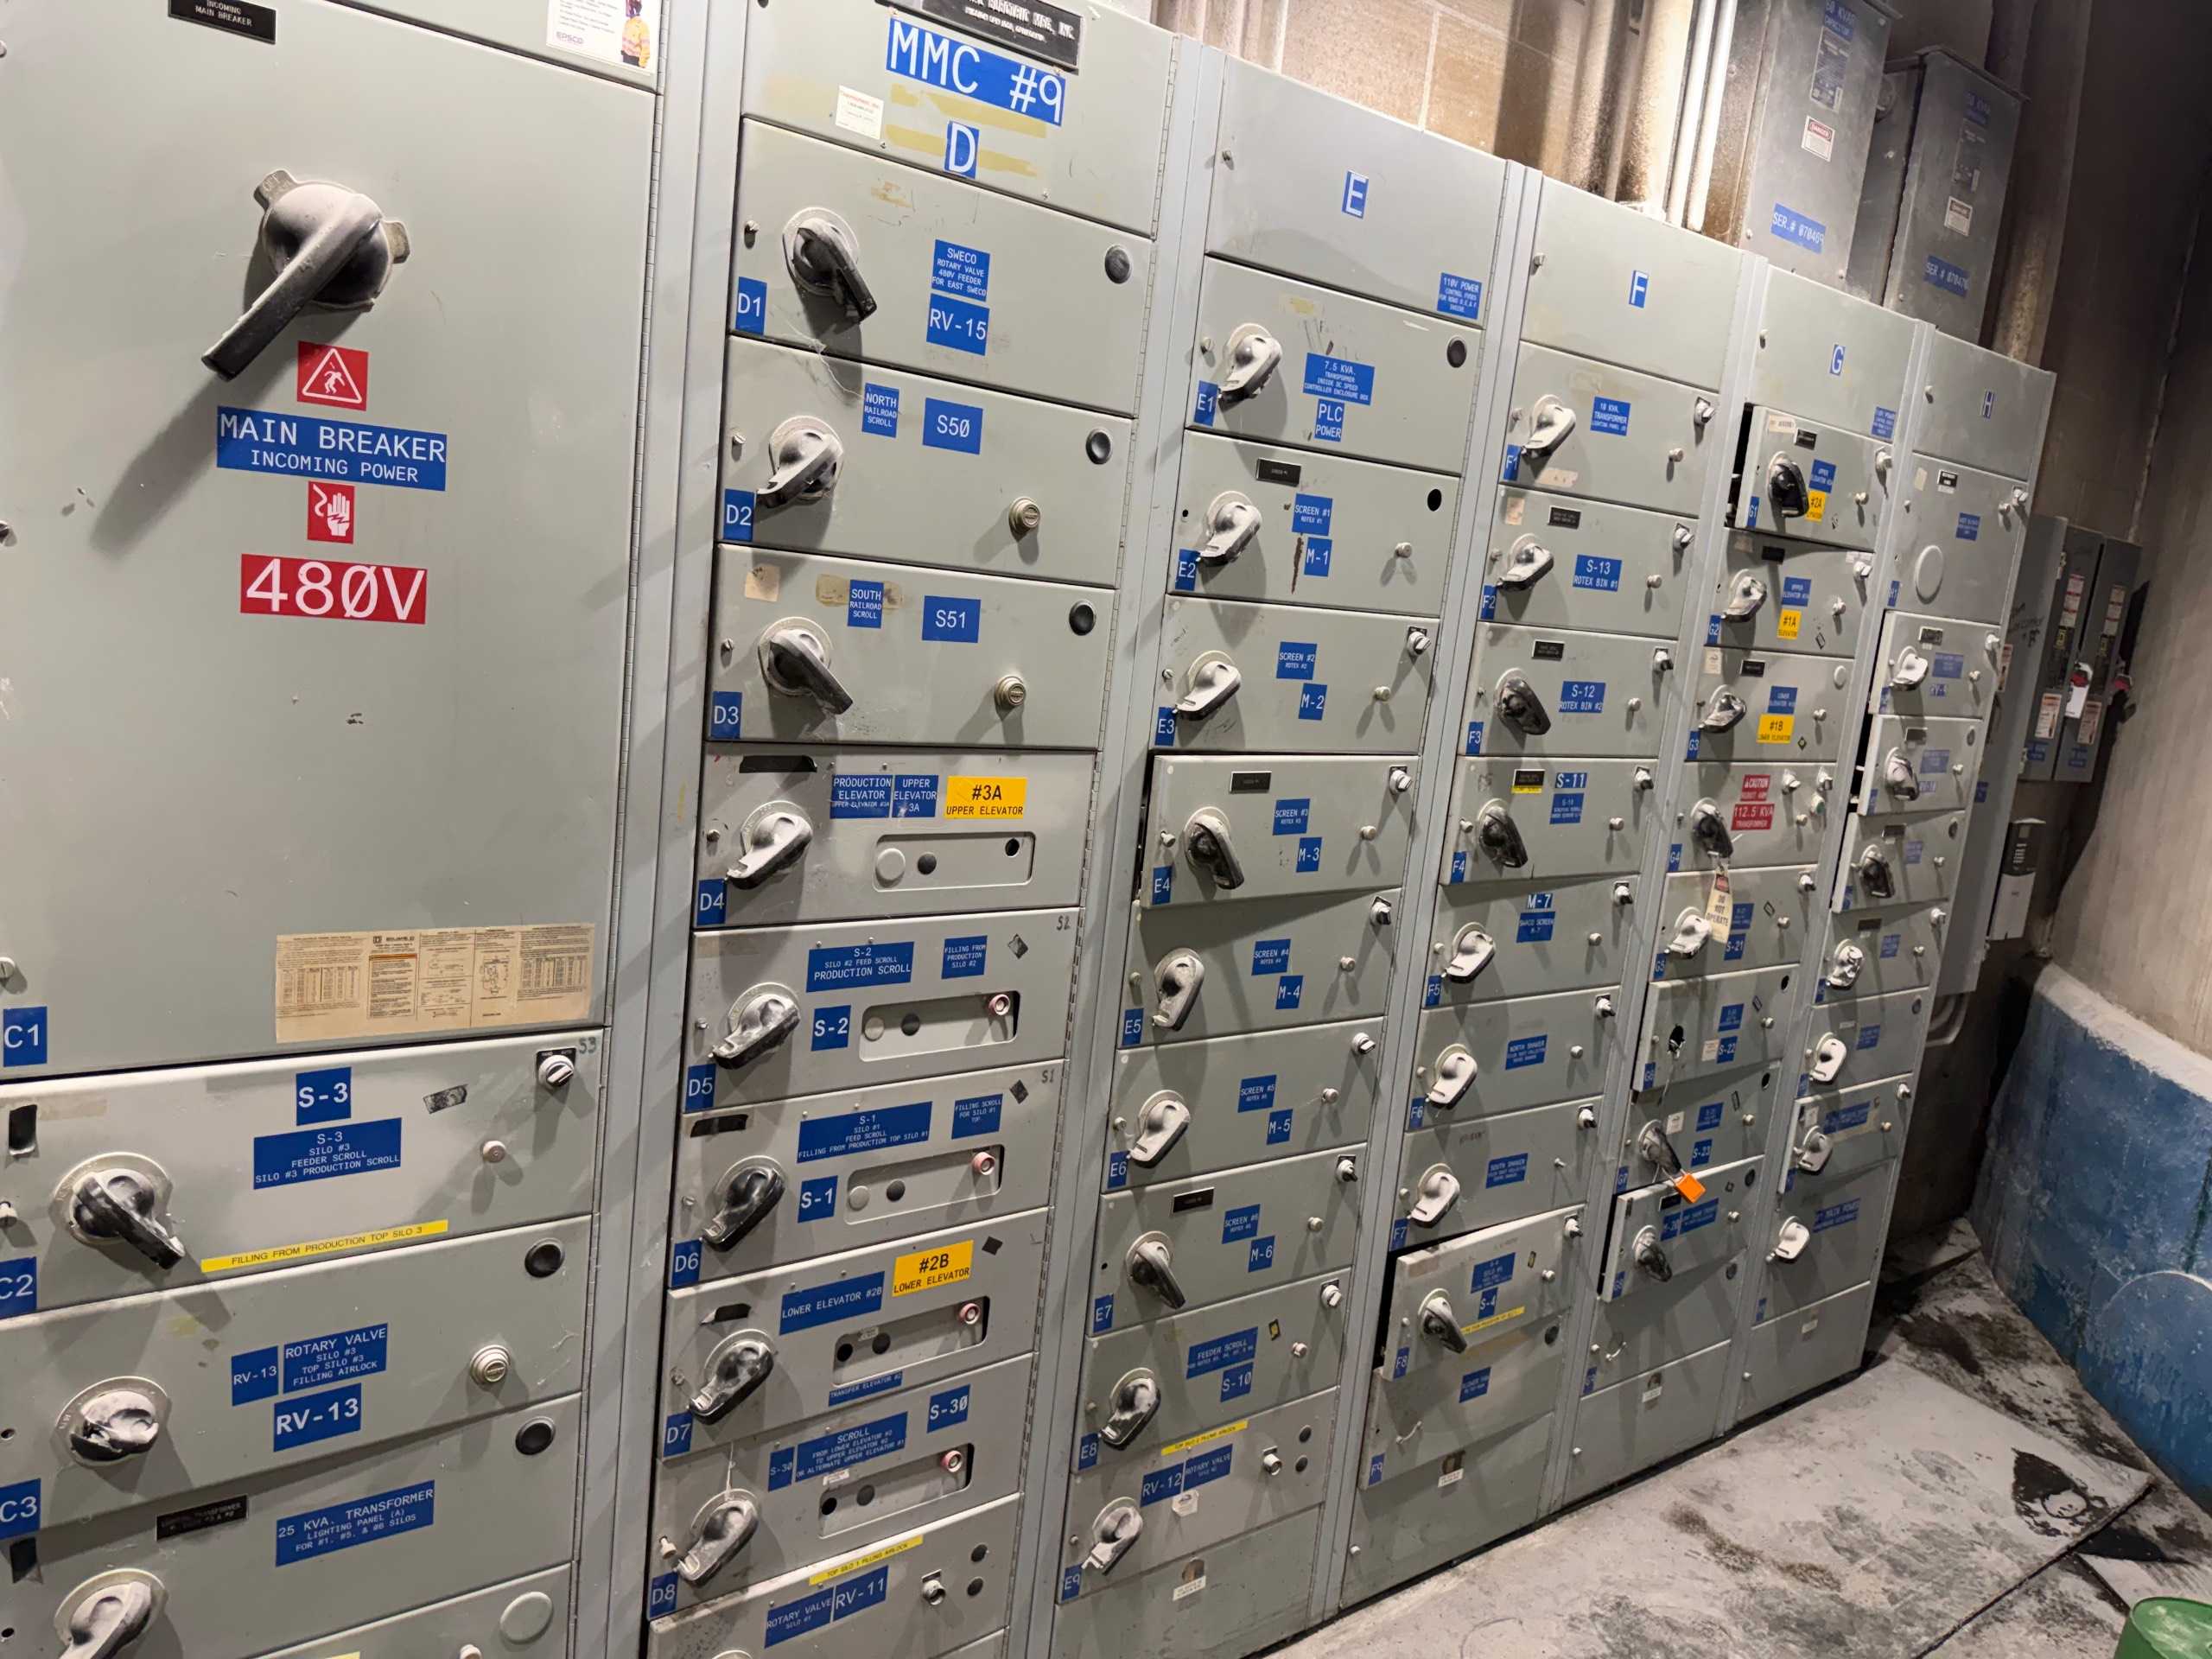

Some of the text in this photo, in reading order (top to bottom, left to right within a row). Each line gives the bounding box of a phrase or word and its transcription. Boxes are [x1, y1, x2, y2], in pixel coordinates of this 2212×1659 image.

[195, 5, 253, 27] MAIN BREAKER
[890, 21, 981, 93] MMC
[1010, 65, 1064, 123] #9
[949, 122, 976, 173] D
[1346, 172, 1368, 216] E
[947, 247, 976, 264] SWECO
[938, 258, 984, 277] ROTARY VALVE
[958, 273, 982, 286] FEEDER
[1630, 270, 1649, 304] F
[738, 293, 761, 317] D1
[930, 308, 986, 340] RV-15
[1325, 360, 1338, 372] 7.5
[1831, 345, 1844, 374] G
[866, 393, 897, 407] NORTH
[1198, 394, 1213, 412] E1
[1319, 403, 1344, 423] PLC
[868, 416, 893, 428] SCROLL
[936, 415, 970, 437] S50
[220, 413, 446, 463] MAIN BREAKER
[1315, 424, 1341, 439] POWER
[251, 449, 418, 482] INCOMING POWER
[1506, 454, 1517, 471] F1
[727, 504, 752, 526] D2
[1294, 504, 1319, 517] SCREEN
[1306, 548, 1329, 565] M-1
[1178, 562, 1196, 579] E2
[1586, 558, 1611, 575] S-13
[1574, 575, 1609, 588] ROTEX BIN
[851, 588, 881, 601] SOUTH
[1482, 594, 1497, 610] F2
[849, 601, 882, 611] RAILROAD
[853, 610, 877, 619] SCROLL
[935, 610, 966, 629] S51
[1783, 615, 1797, 627] #1A
[1708, 623, 1719, 636] G2
[1279, 652, 1316, 663] SCREEN #2
[1571, 684, 1595, 698] S-12
[1301, 694, 1325, 709] M-2
[1559, 701, 1593, 710] ROTEX BIN
[714, 705, 739, 725] D3
[1158, 718, 1175, 735] E3
[1769, 720, 1783, 732] #1B
[1469, 730, 1482, 745] F3
[1689, 739, 1700, 751] G3
[833, 778, 891, 788] PRODUCTION
[903, 779, 930, 788] UPPER
[1556, 773, 1586, 788] S-11
[839, 790, 886, 800] ELEVATOR
[894, 791, 938, 801] ELEVATOR
[972, 785, 1002, 801] #3A
[946, 805, 1023, 816] UPPER ELEVATOR
[1275, 808, 1300, 818] SCREEN
[1734, 805, 1774, 818] 112.5 KVA
[1298, 847, 1320, 862] M-3
[1669, 850, 1681, 863] G4
[1452, 859, 1465, 873] F4
[1154, 876, 1171, 893] E4
[700, 893, 725, 910] D4
[1527, 893, 1553, 908] M-7
[1706, 912, 1728, 926] OPERATE
[854, 947, 872, 957] S-2
[1255, 949, 1279, 958] SCREEN
[1726, 940, 1744, 953] S-21
[814, 963, 911, 981] PRODUCTION SCROLL
[1278, 984, 1300, 1000] M-4
[1428, 983, 1440, 996] F5
[814, 1017, 849, 1037] S-2
[1124, 1018, 1141, 1034] E5
[3, 1024, 40, 1048] C1
[1719, 1042, 1736, 1056] S-22
[689, 1077, 713, 1096] D5
[1241, 1087, 1265, 1096] SCREEN
[298, 1083, 348, 1108] S-3
[860, 1114, 876, 1125] S-1
[1411, 1105, 1424, 1119] F6
[1268, 1118, 1291, 1135] M-5
[317, 1131, 343, 1144] S-3
[309, 1143, 350, 1156] SILO #3
[291, 1150, 367, 1168] FEEDER SCROLL
[256, 1155, 400, 1184] SILO #3 PRODUCTION SCROLL
[1110, 1161, 1127, 1177] E6
[801, 1188, 834, 1209] S-1
[1224, 1216, 1249, 1228] SCREEN
[1394, 1227, 1407, 1240] F7
[232, 1228, 413, 1265] FILLING FROM PRODUCTION TOP SILO
[1250, 1244, 1274, 1262] M-6
[675, 1253, 699, 1273] D6
[918, 1253, 949, 1274] #2B
[0, 1274, 34, 1300] C2
[894, 1267, 969, 1294] LOWER ELEVATOR
[782, 1291, 861, 1319] LOWER ELEVATOR
[1479, 1294, 1497, 1310] S-4
[1095, 1304, 1113, 1322] E7
[285, 1327, 386, 1359] ROTARY VALVE
[1197, 1345, 1222, 1359] FEEDER
[1224, 1339, 1247, 1353] SCROLL
[316, 1351, 340, 1363] SILO
[1396, 1354, 1408, 1368] F8
[293, 1361, 378, 1386] FILLING AIRLOCK
[302, 1357, 348, 1375] TOP SILO
[233, 1366, 277, 1385] RV-13
[1222, 1371, 1252, 1393] S-10
[276, 1398, 359, 1434] RV-13
[930, 1394, 969, 1421] S-30
[667, 1425, 690, 1445] D7
[837, 1427, 869, 1444] SCROLL
[1081, 1443, 1097, 1460] E8
[1185, 1461, 1209, 1476] ROTARY
[1142, 1471, 1183, 1497] RV-12
[0, 1496, 37, 1522] C3
[278, 1489, 433, 1538] 25 TRANSFORMER
[308, 1514, 385, 1540] LIGHTING PANEL
[1064, 1574, 1081, 1592] E9
[652, 1584, 676, 1605] D8
[836, 1578, 886, 1611] RV-11
[766, 1599, 832, 1630] ROTARY VALVE
